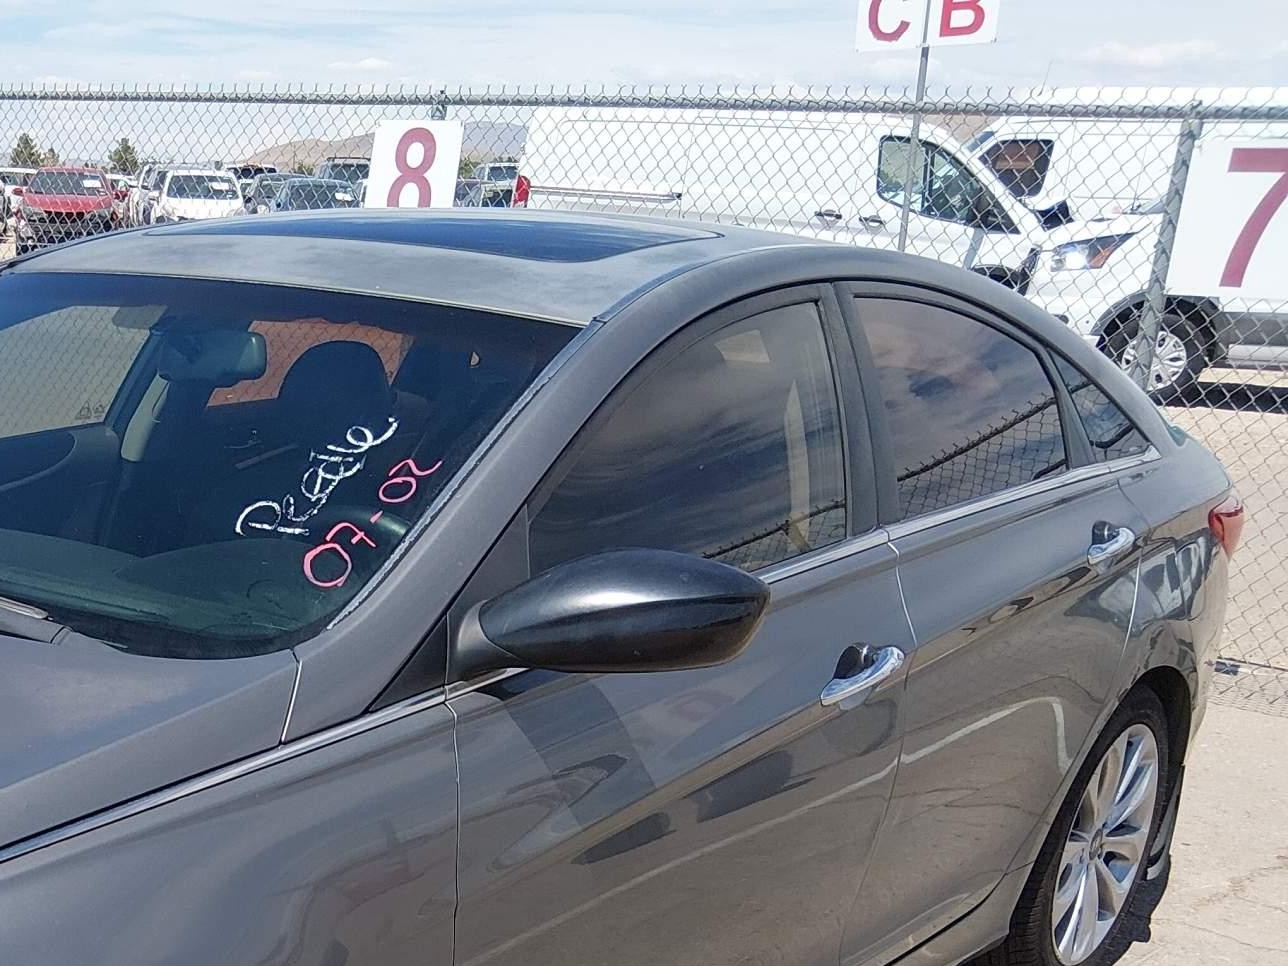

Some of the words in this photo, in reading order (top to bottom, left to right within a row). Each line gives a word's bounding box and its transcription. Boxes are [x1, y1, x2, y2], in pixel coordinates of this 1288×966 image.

[869, 0, 910, 42] C
[939, 0, 985, 37] B
[387, 127, 436, 207] 8
[1219, 148, 1288, 288] 7
